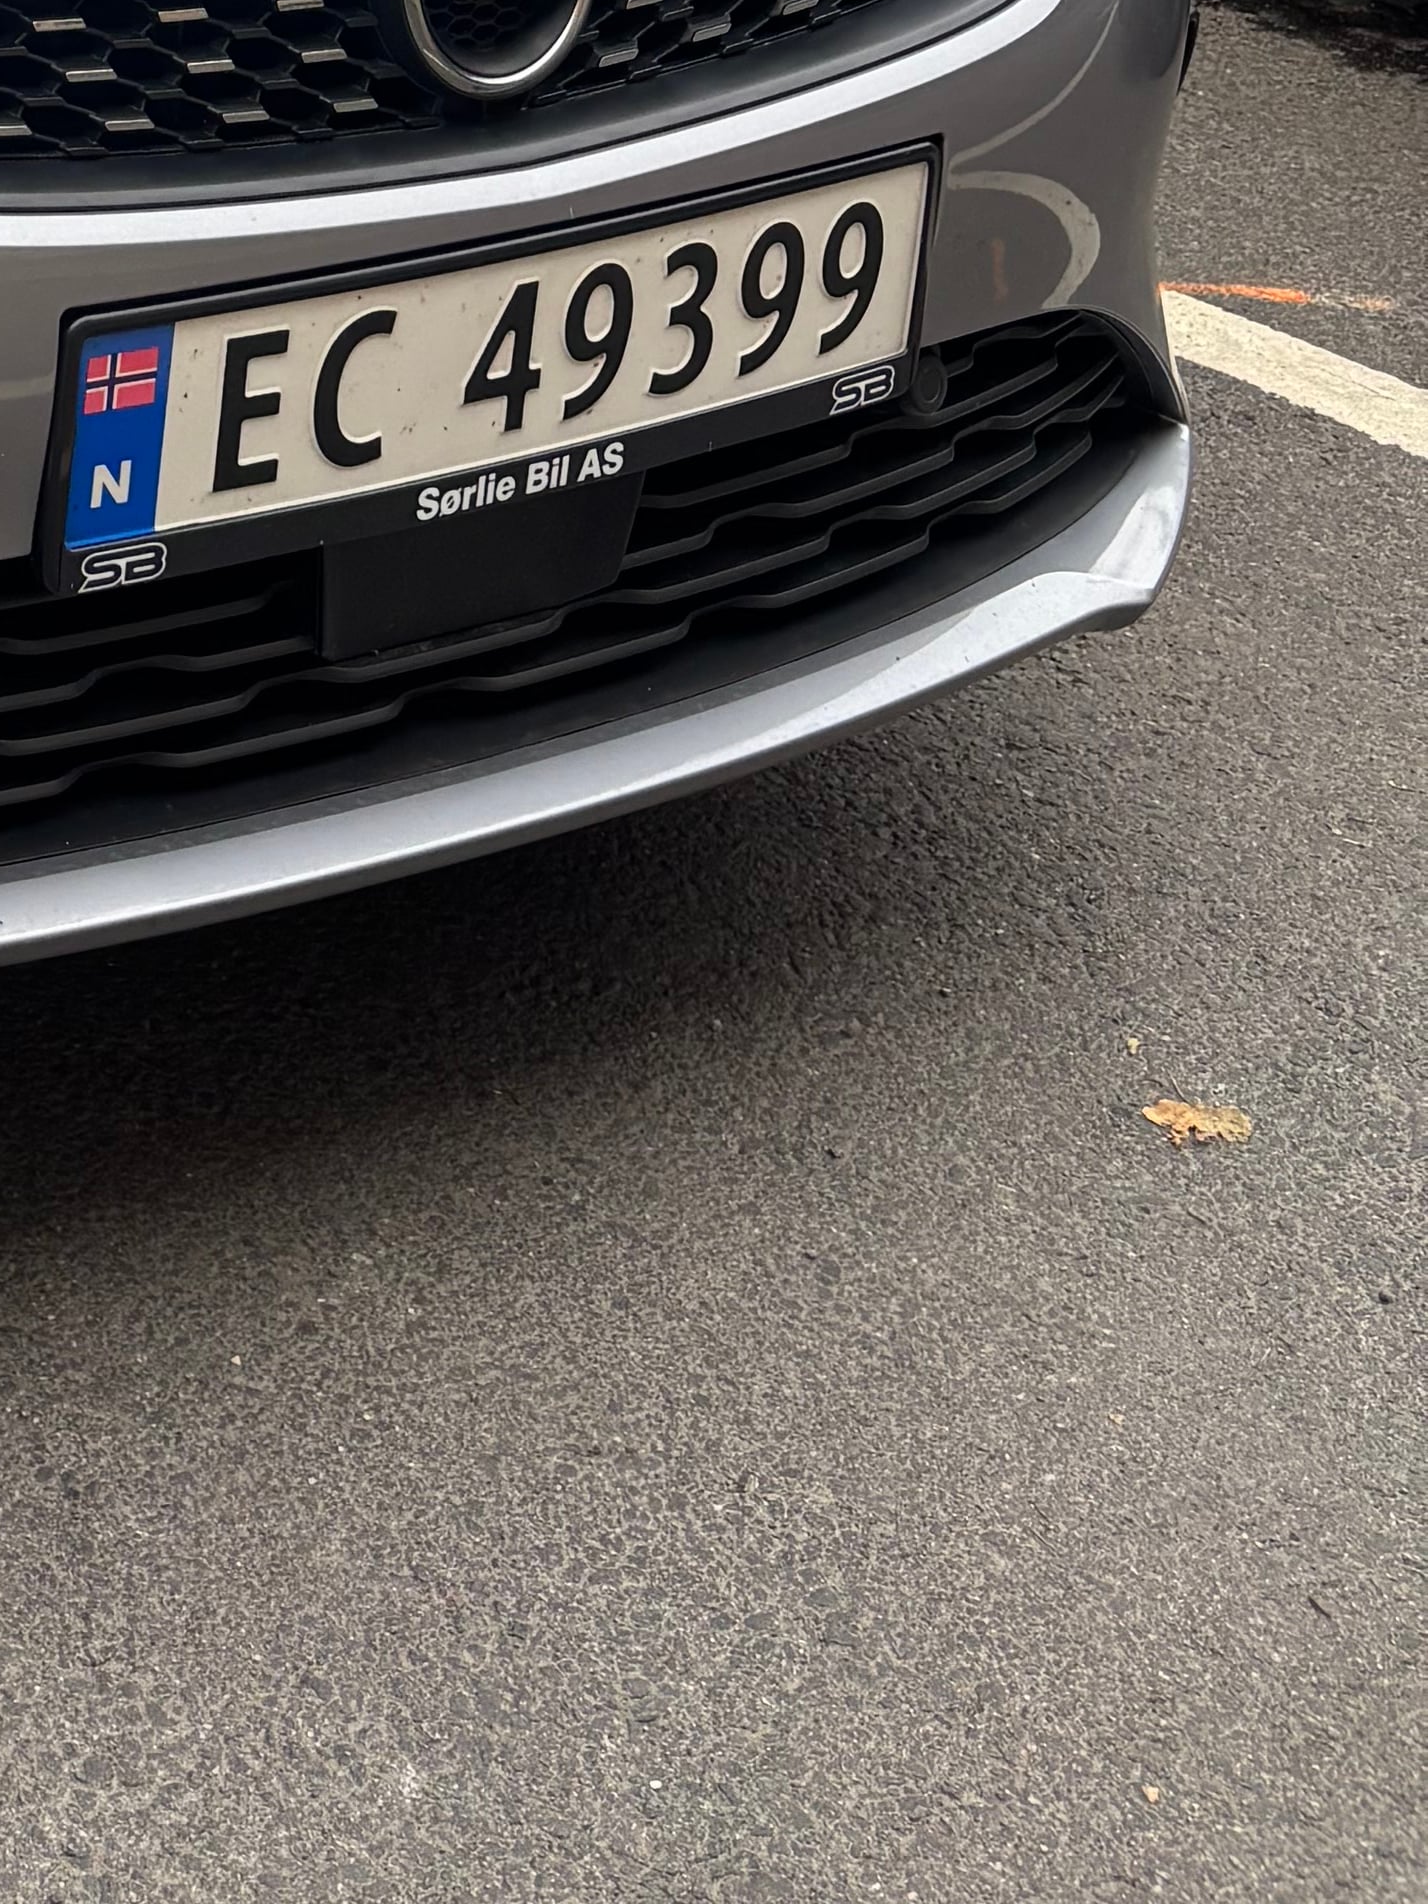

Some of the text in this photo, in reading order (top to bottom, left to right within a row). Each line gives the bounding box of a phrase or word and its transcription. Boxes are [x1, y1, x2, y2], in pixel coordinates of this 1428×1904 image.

[210, 200, 885, 494] EC 49399
[88, 458, 132, 510] N
[416, 440, 626, 523] Sørlie Bil AS
